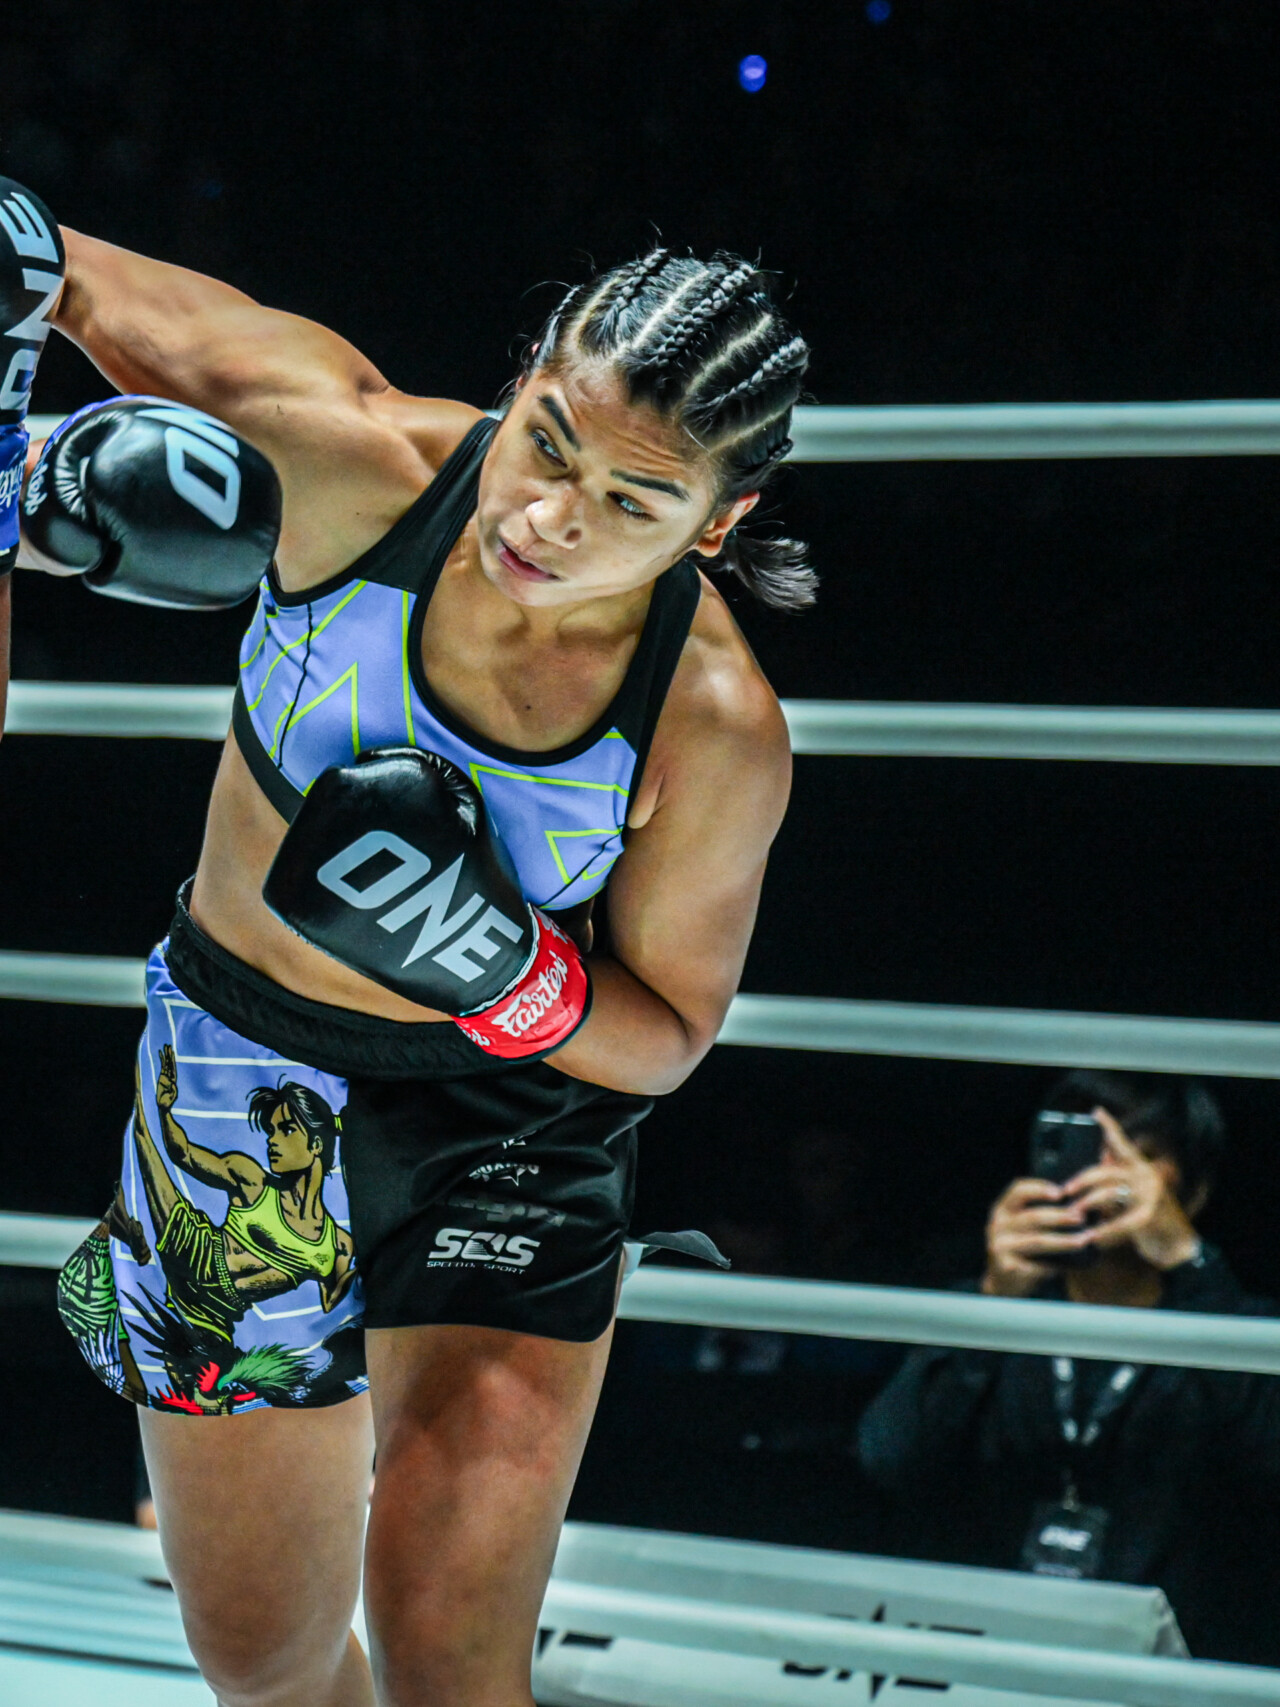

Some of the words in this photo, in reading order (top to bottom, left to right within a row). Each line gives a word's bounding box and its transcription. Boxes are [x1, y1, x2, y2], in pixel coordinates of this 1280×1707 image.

[135, 407, 242, 531] ON
[316, 830, 524, 983] ONE
[491, 949, 569, 1038] Fairtex
